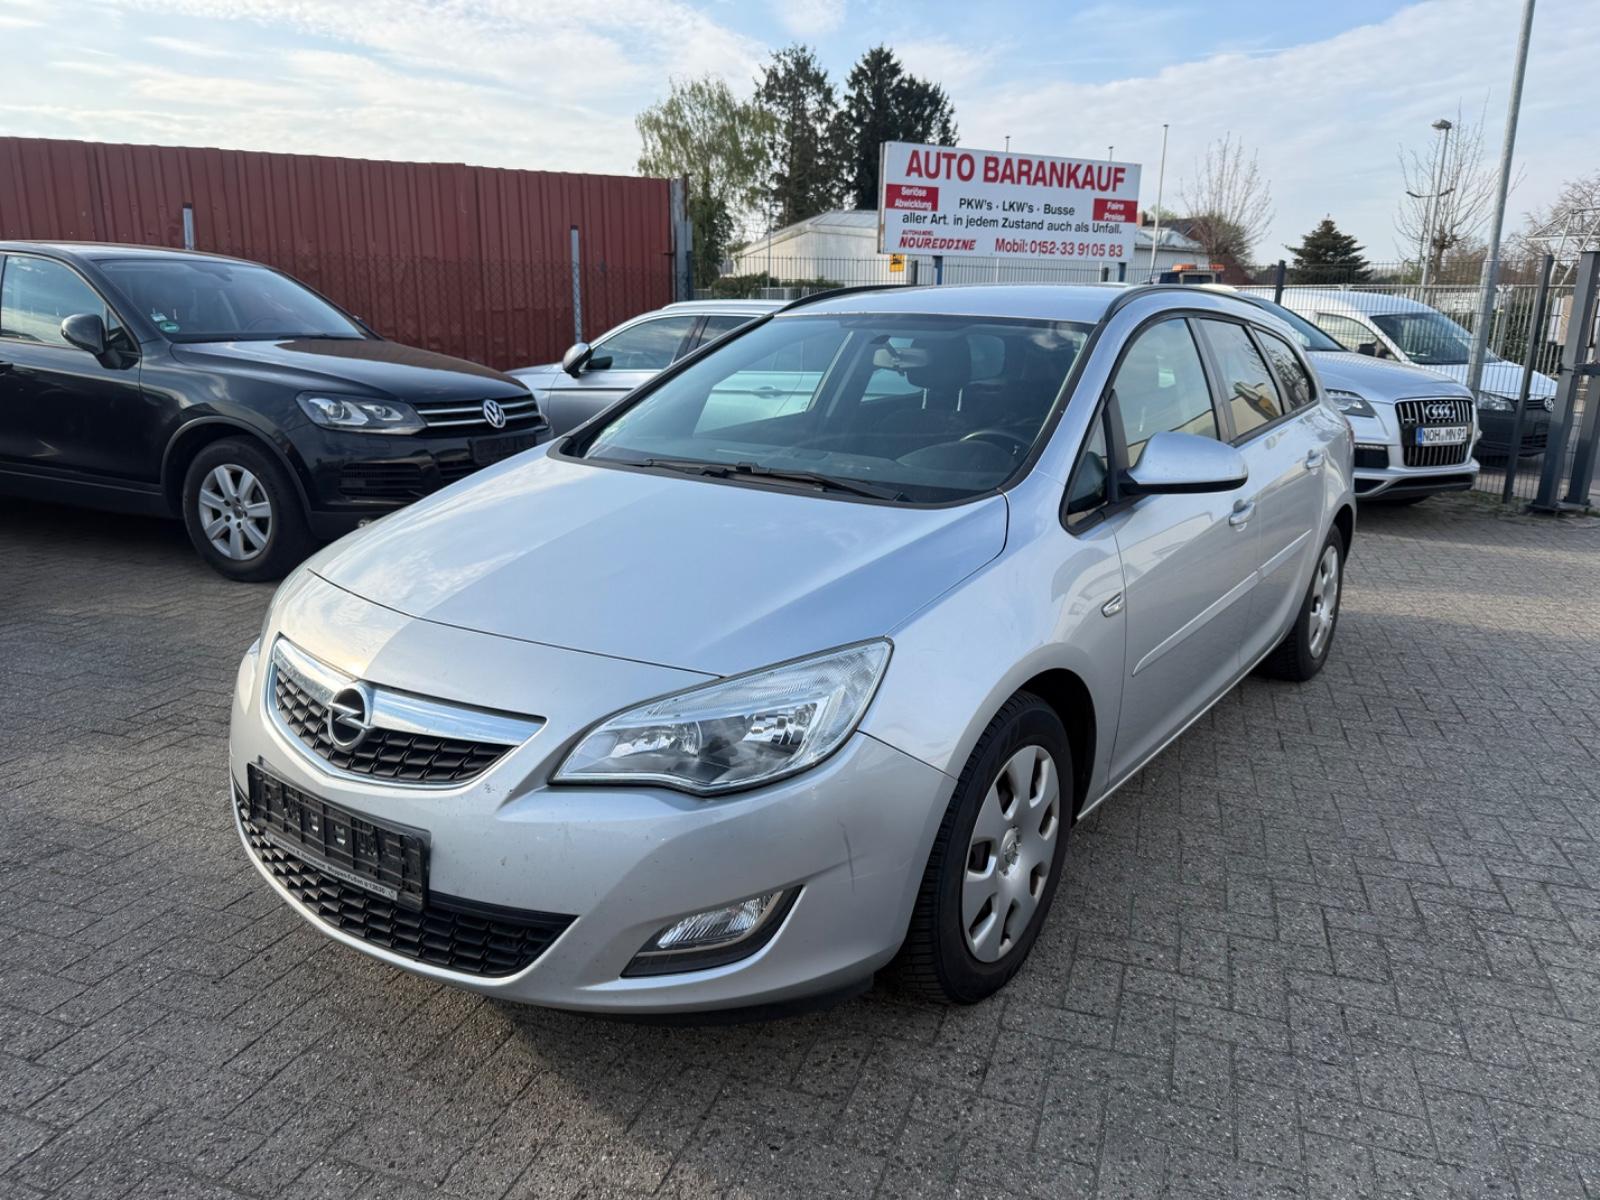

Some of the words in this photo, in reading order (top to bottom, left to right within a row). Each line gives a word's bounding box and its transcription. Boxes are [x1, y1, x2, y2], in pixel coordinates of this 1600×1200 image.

[905, 149, 975, 182] AUTO
[982, 156, 1126, 192] BARANKAUF
[959, 198, 992, 211] PKW's
[1002, 201, 1034, 213] LKW's
[1043, 204, 1075, 216] Busse
[1106, 201, 1124, 210] Faire
[902, 212, 927, 224] aller
[953, 215, 963, 226] in
[965, 216, 998, 229] jedem
[1001, 217, 1044, 230] Zustand
[1047, 221, 1072, 232] auch
[1074, 222, 1089, 233] als
[1092, 222, 1122, 234] Unfall.
[898, 236, 976, 251] NOUREDDINE
[995, 238, 1028, 254] Mobil:
[1108, 244, 1124, 258] 83
